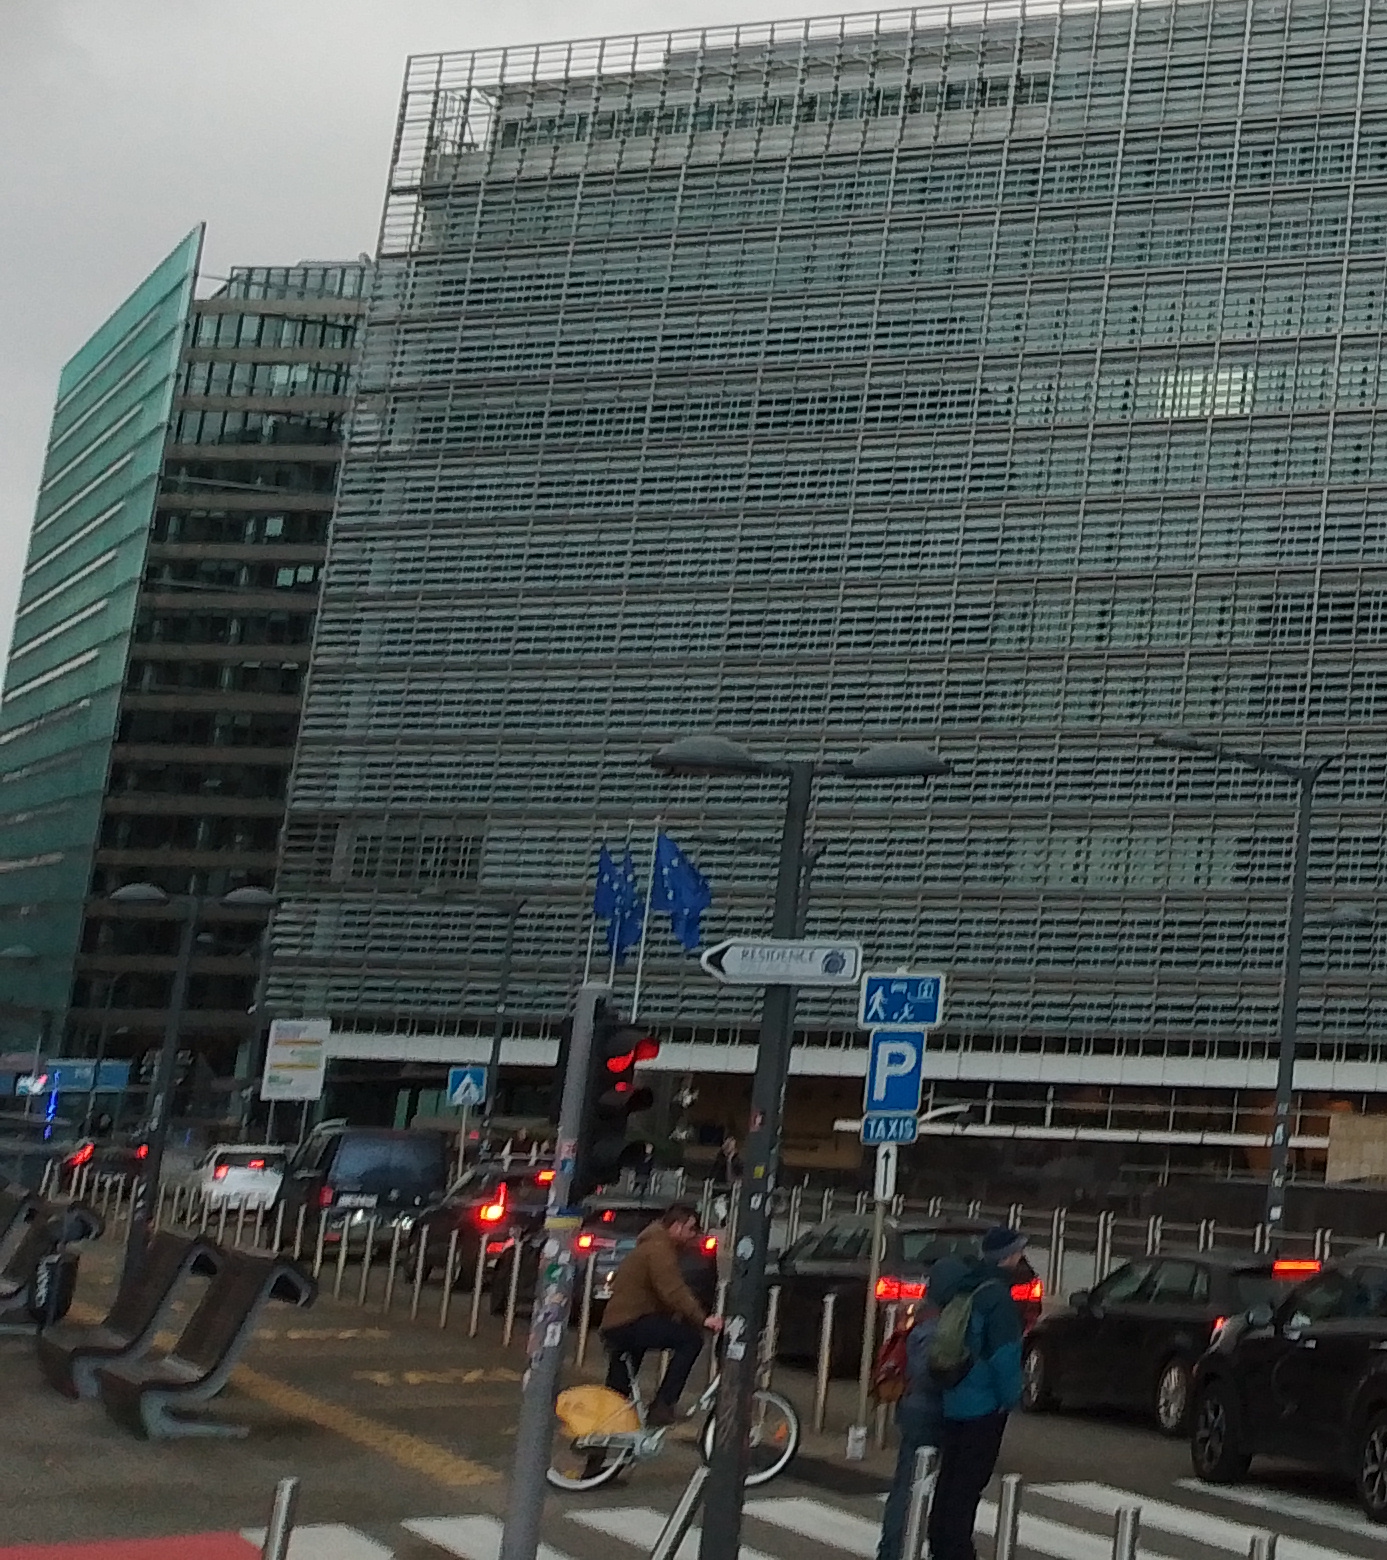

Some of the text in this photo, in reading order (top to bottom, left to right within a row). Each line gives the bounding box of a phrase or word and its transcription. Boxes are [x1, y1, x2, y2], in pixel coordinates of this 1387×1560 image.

[741, 947, 816, 963] RESIDENCE
[872, 1041, 917, 1102] P
[867, 1118, 915, 1140] TAXIS
